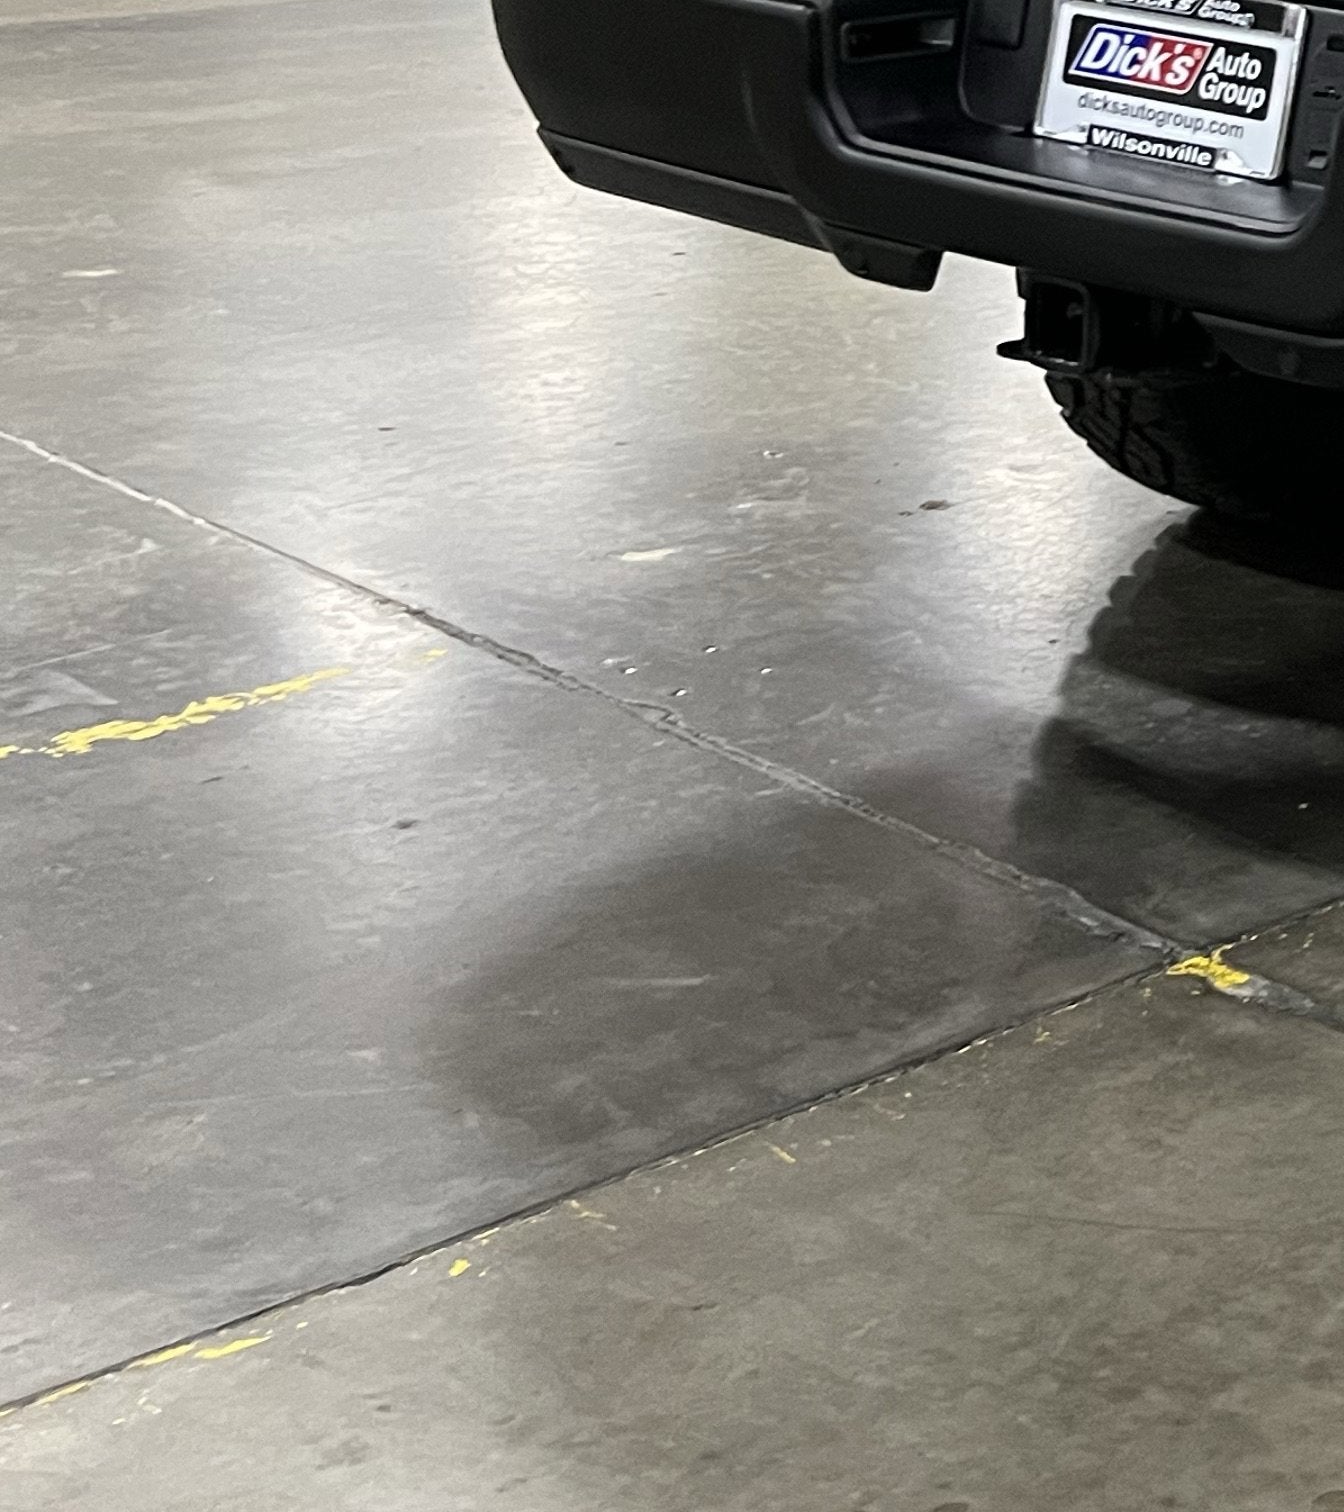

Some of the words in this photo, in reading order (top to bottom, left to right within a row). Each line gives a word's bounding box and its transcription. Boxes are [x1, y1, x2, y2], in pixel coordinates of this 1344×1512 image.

[1079, 31, 1196, 87] Dick's
[1205, 46, 1262, 81] Auto
[1077, 91, 1245, 139] dicksautogroup.com
[1197, 72, 1267, 114] Group
[1090, 126, 1214, 167] Wilsonville
